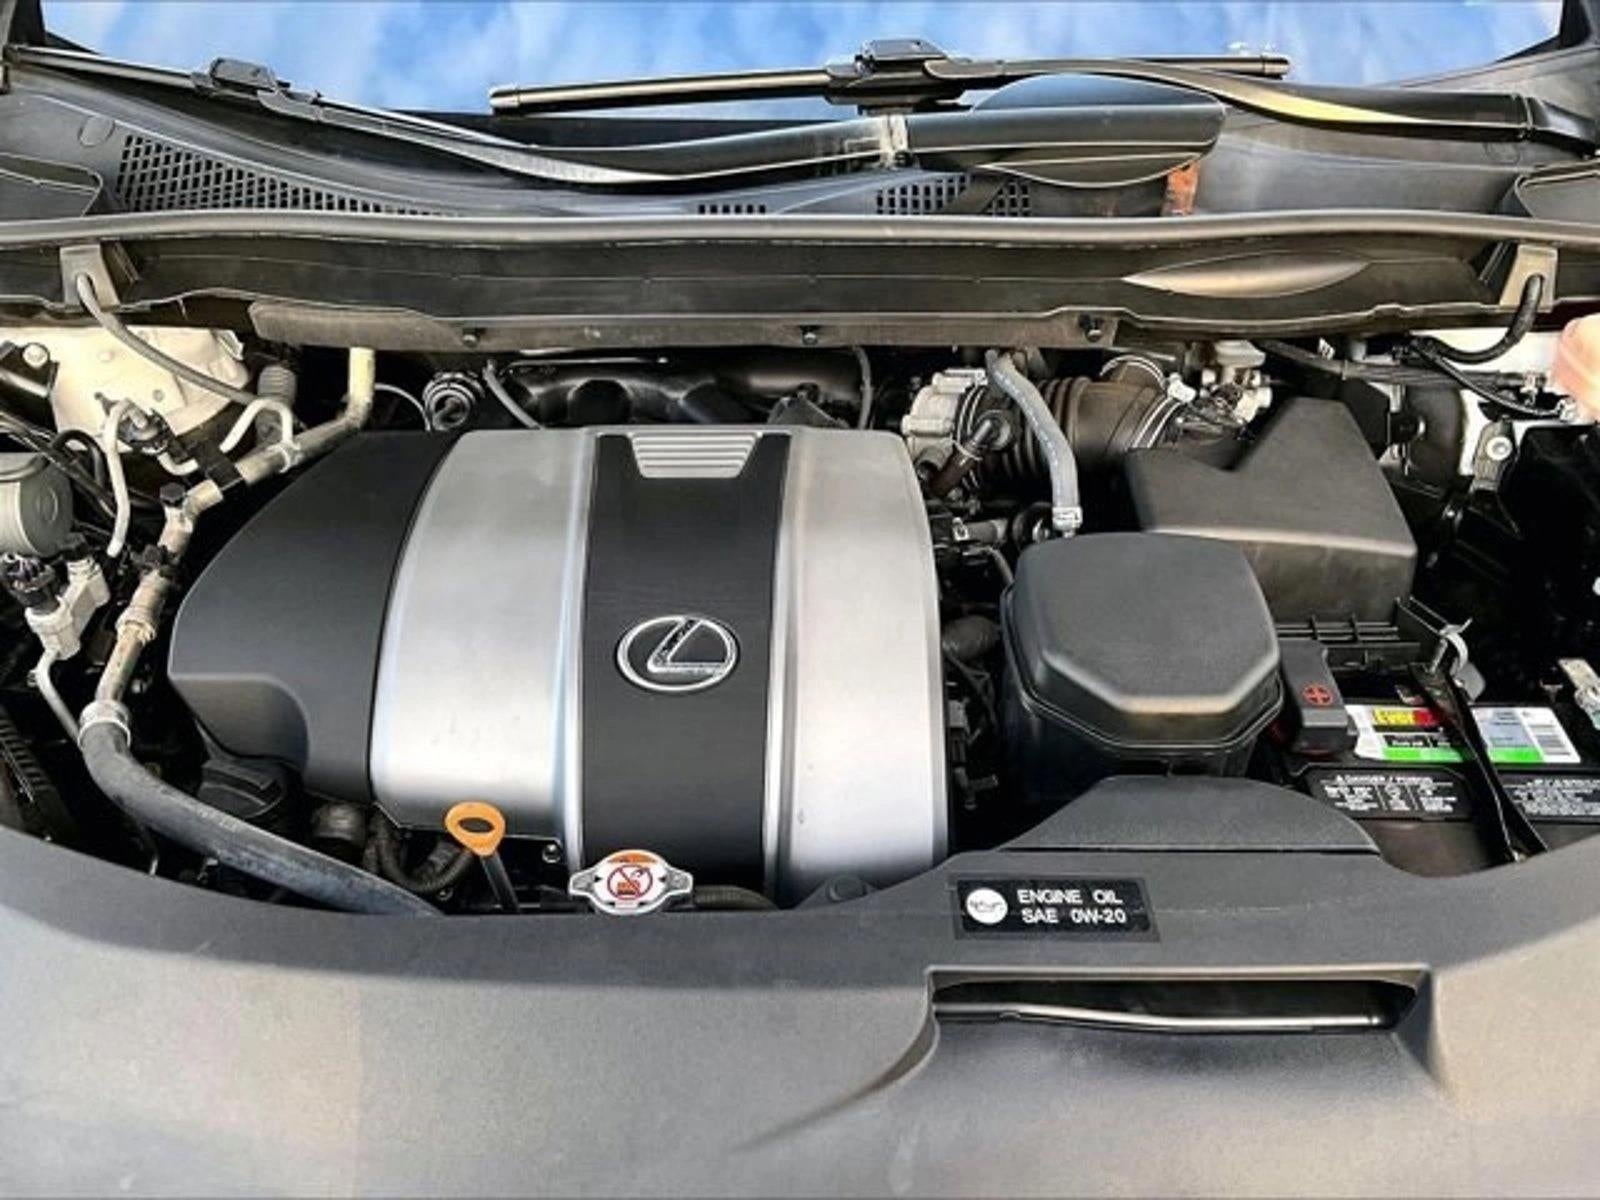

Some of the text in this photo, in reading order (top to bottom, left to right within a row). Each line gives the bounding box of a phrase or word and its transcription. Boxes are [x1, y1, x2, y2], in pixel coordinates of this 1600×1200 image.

[1017, 889, 1123, 904] ENGINE OIL
[1021, 908, 1126, 924] SAE 0W-20
